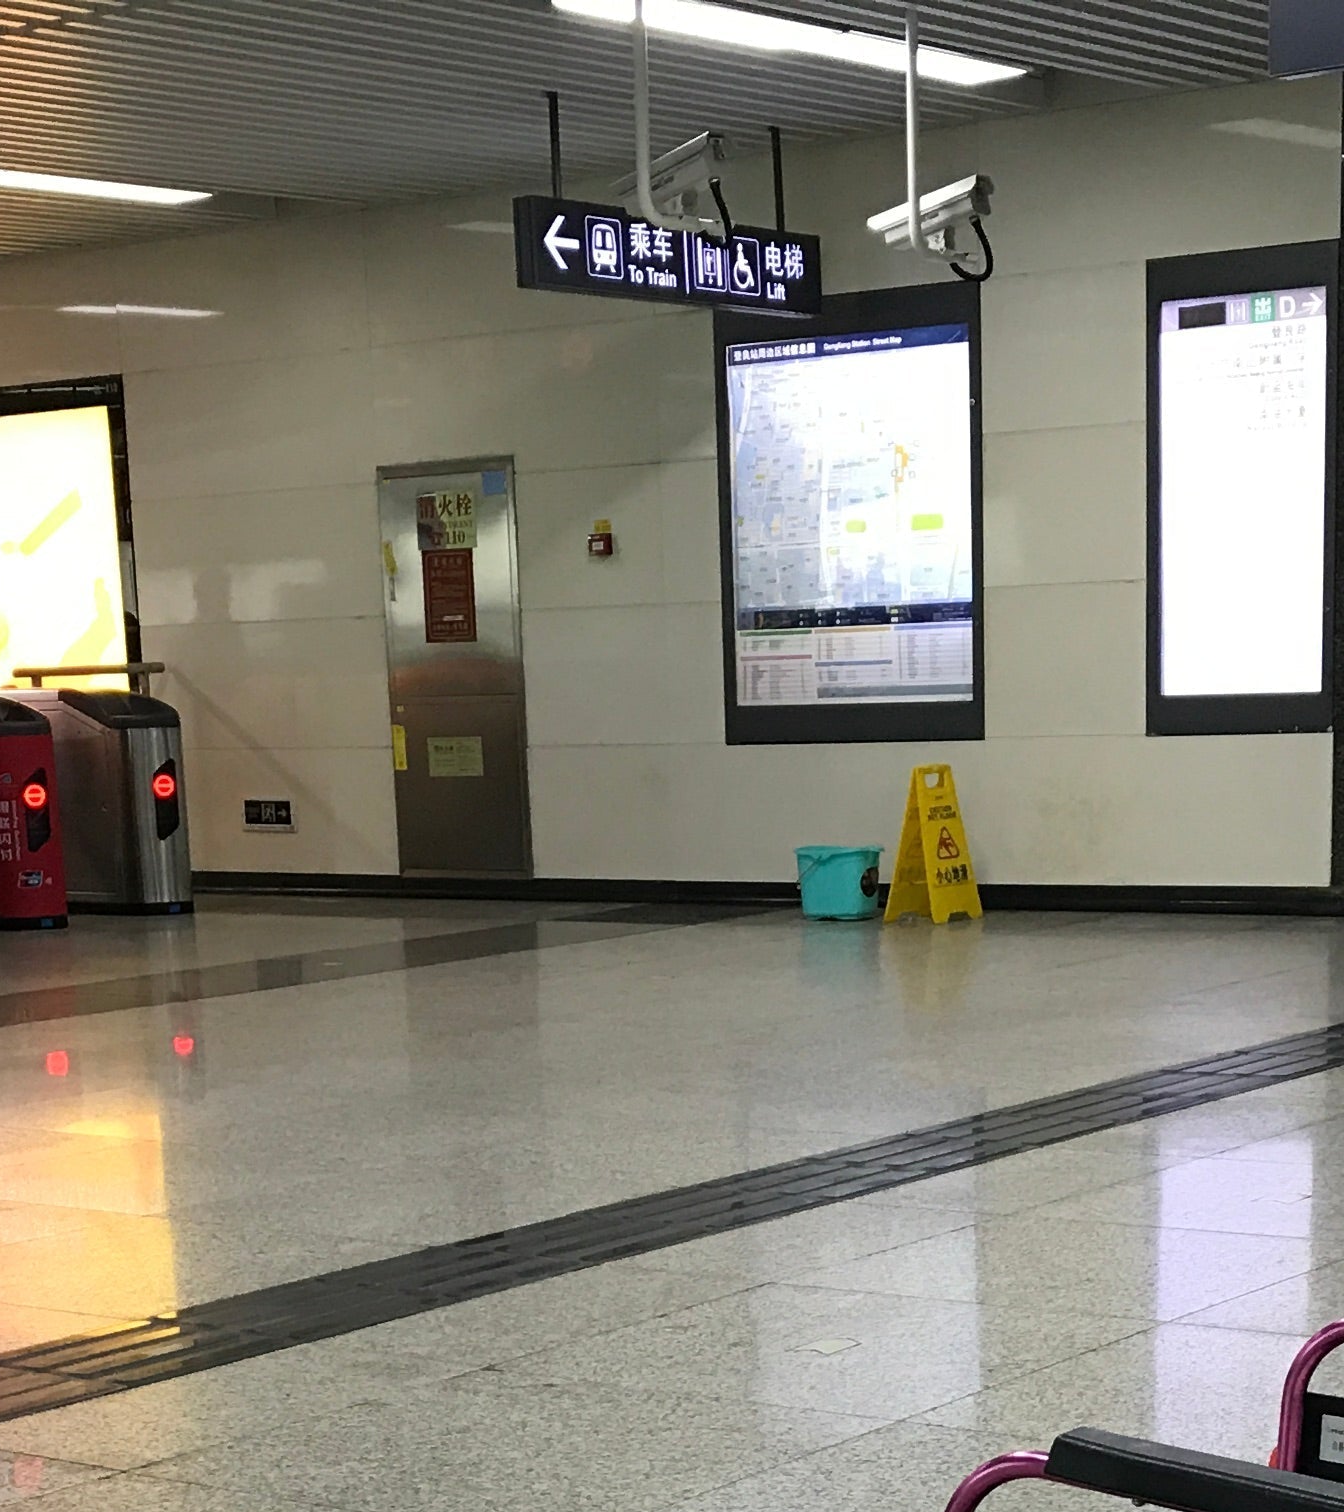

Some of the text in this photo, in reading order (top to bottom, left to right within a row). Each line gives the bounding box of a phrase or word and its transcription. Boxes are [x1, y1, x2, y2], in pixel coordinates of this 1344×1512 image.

[628, 222, 674, 263] 乘车
[764, 241, 804, 280] 电梯
[627, 264, 677, 288] To Train
[766, 282, 786, 301] Lift
[1279, 295, 1296, 318] D
